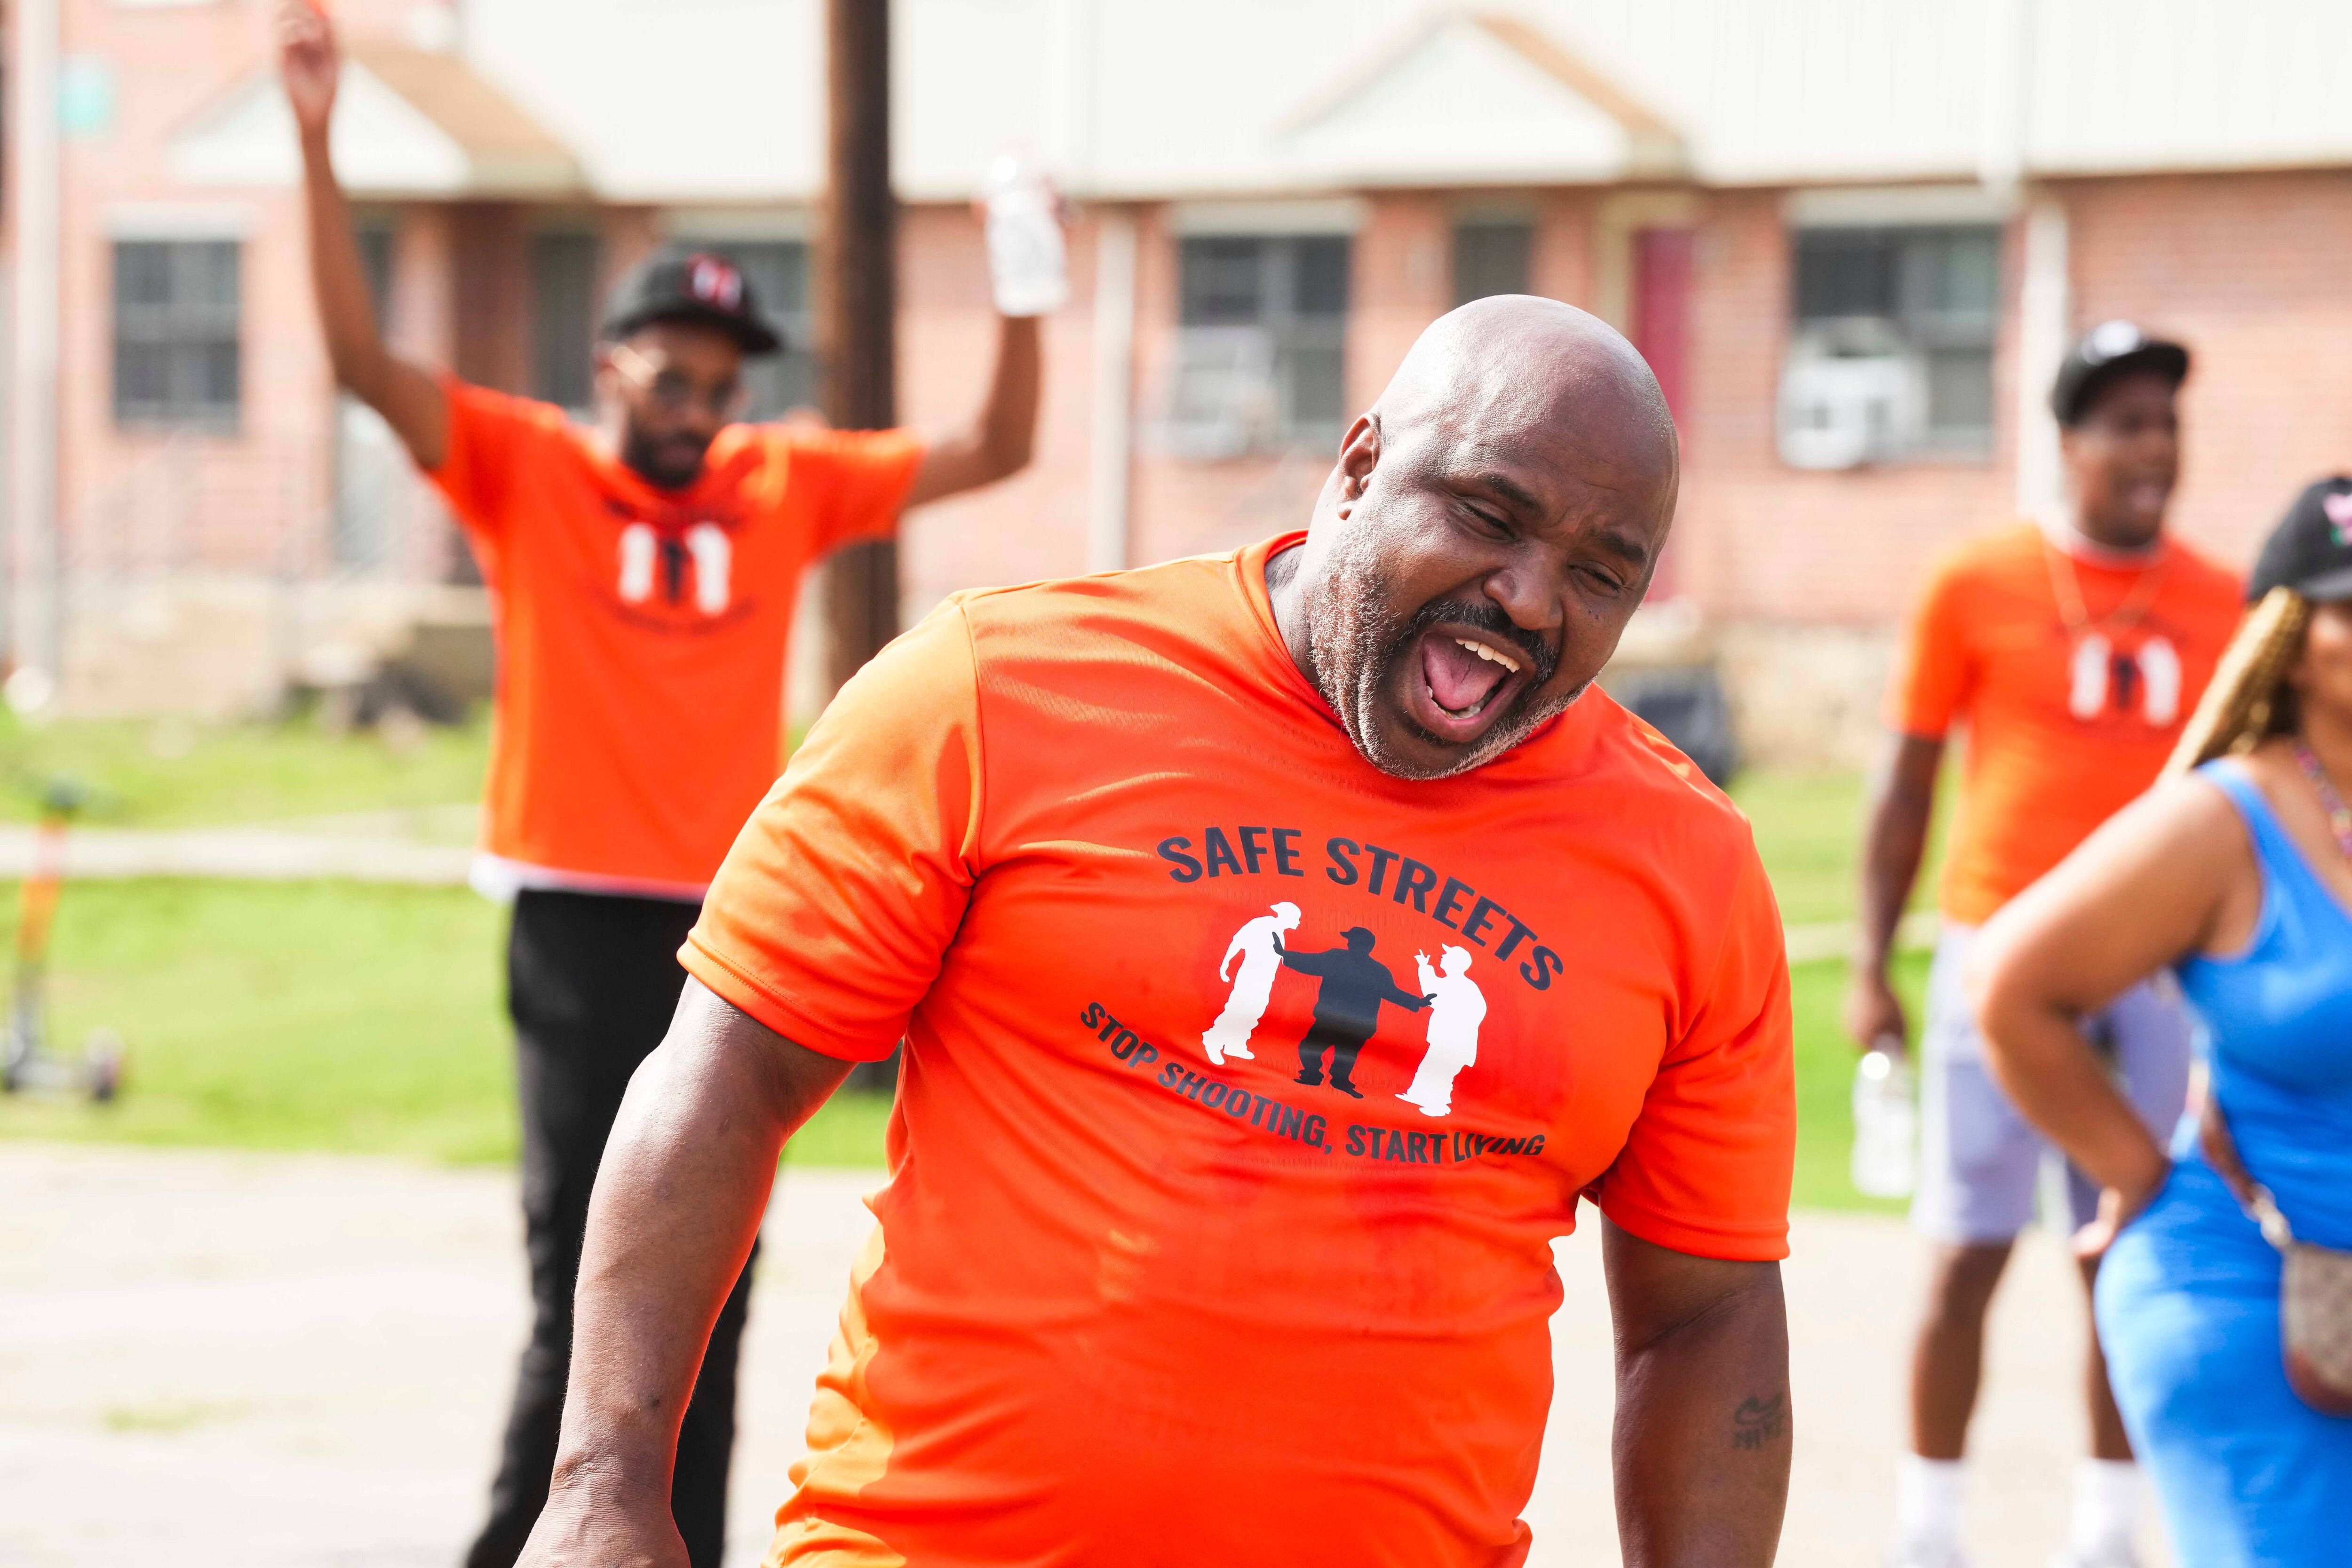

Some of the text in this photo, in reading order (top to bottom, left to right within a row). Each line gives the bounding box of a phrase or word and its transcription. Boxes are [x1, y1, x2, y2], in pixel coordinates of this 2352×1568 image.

[1157, 826, 1563, 991] SAFE STREETS
[1081, 1002, 1546, 1164] STOP SHOOTING, START LIVING
